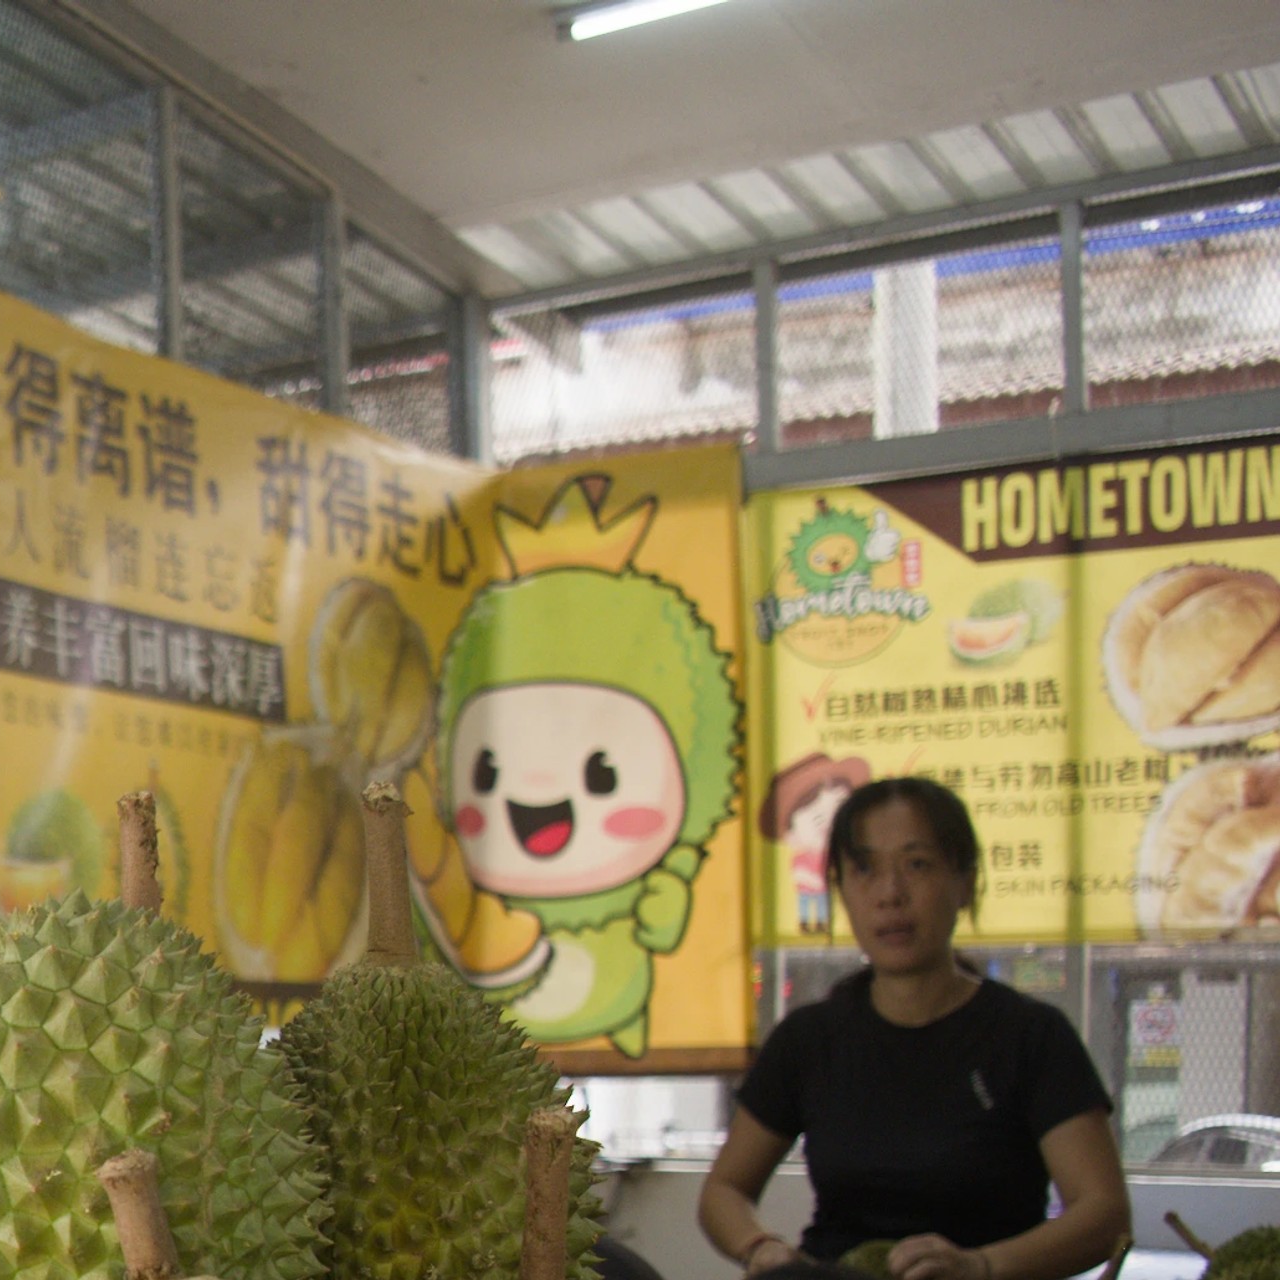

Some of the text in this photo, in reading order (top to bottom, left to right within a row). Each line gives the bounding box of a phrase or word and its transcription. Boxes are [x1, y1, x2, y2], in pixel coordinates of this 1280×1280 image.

[962, 445, 1280, 553] HOMETOWN
[755, 570, 931, 645] Hometown
[978, 713, 1068, 739] DURIAN
[975, 801, 1037, 818] FROM
[1042, 799, 1083, 816] OLD
[994, 872, 1181, 898] SKIN PACKAGING
